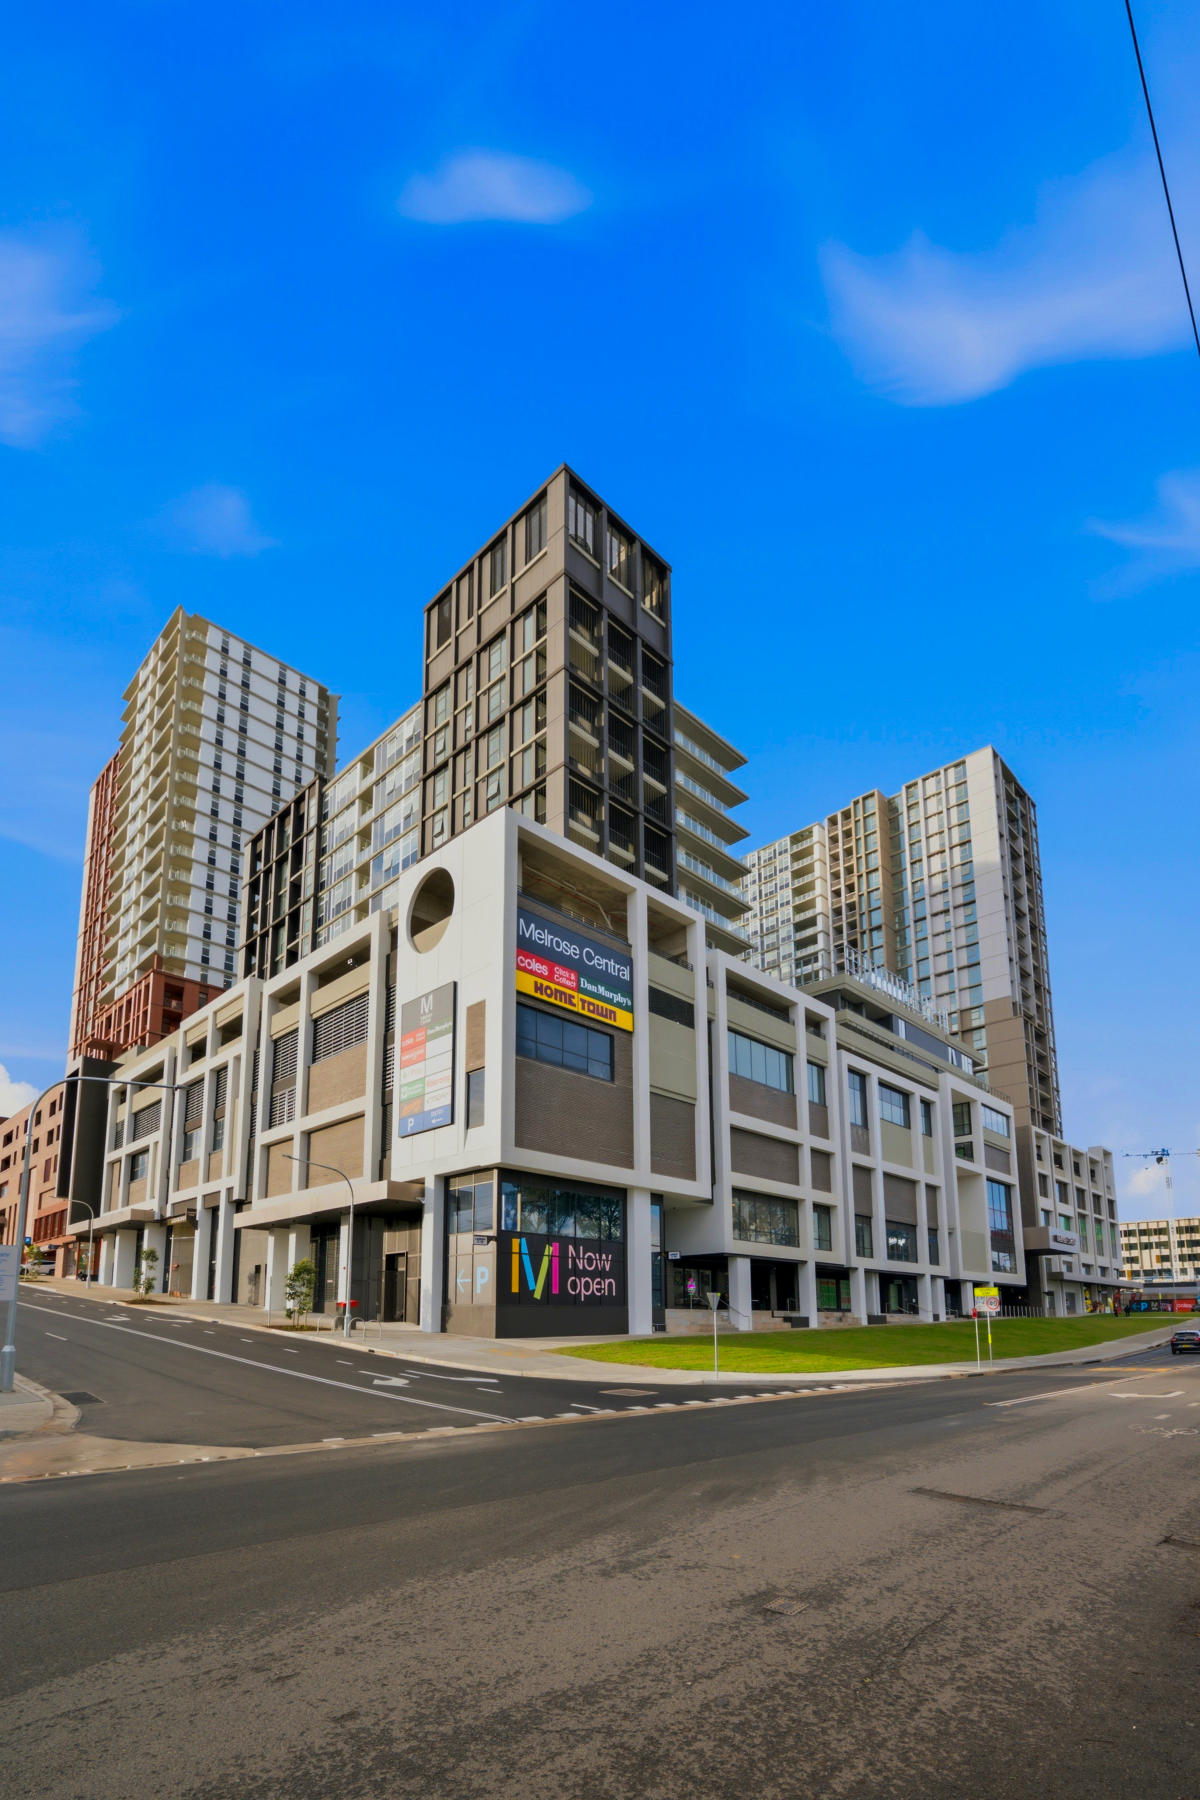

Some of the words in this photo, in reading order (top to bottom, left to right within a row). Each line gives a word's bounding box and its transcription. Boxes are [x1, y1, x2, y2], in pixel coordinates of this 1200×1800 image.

[519, 918, 580, 959] Melrose
[583, 947, 630, 981] Central
[517, 955, 549, 976] coles
[554, 966, 570, 978] Click
[554, 974, 576, 988] Collect
[420, 992, 433, 1015] M
[408, 1118, 414, 1132] P
[568, 1244, 612, 1272] Now
[476, 1266, 489, 1294] P
[567, 1276, 616, 1301] open
